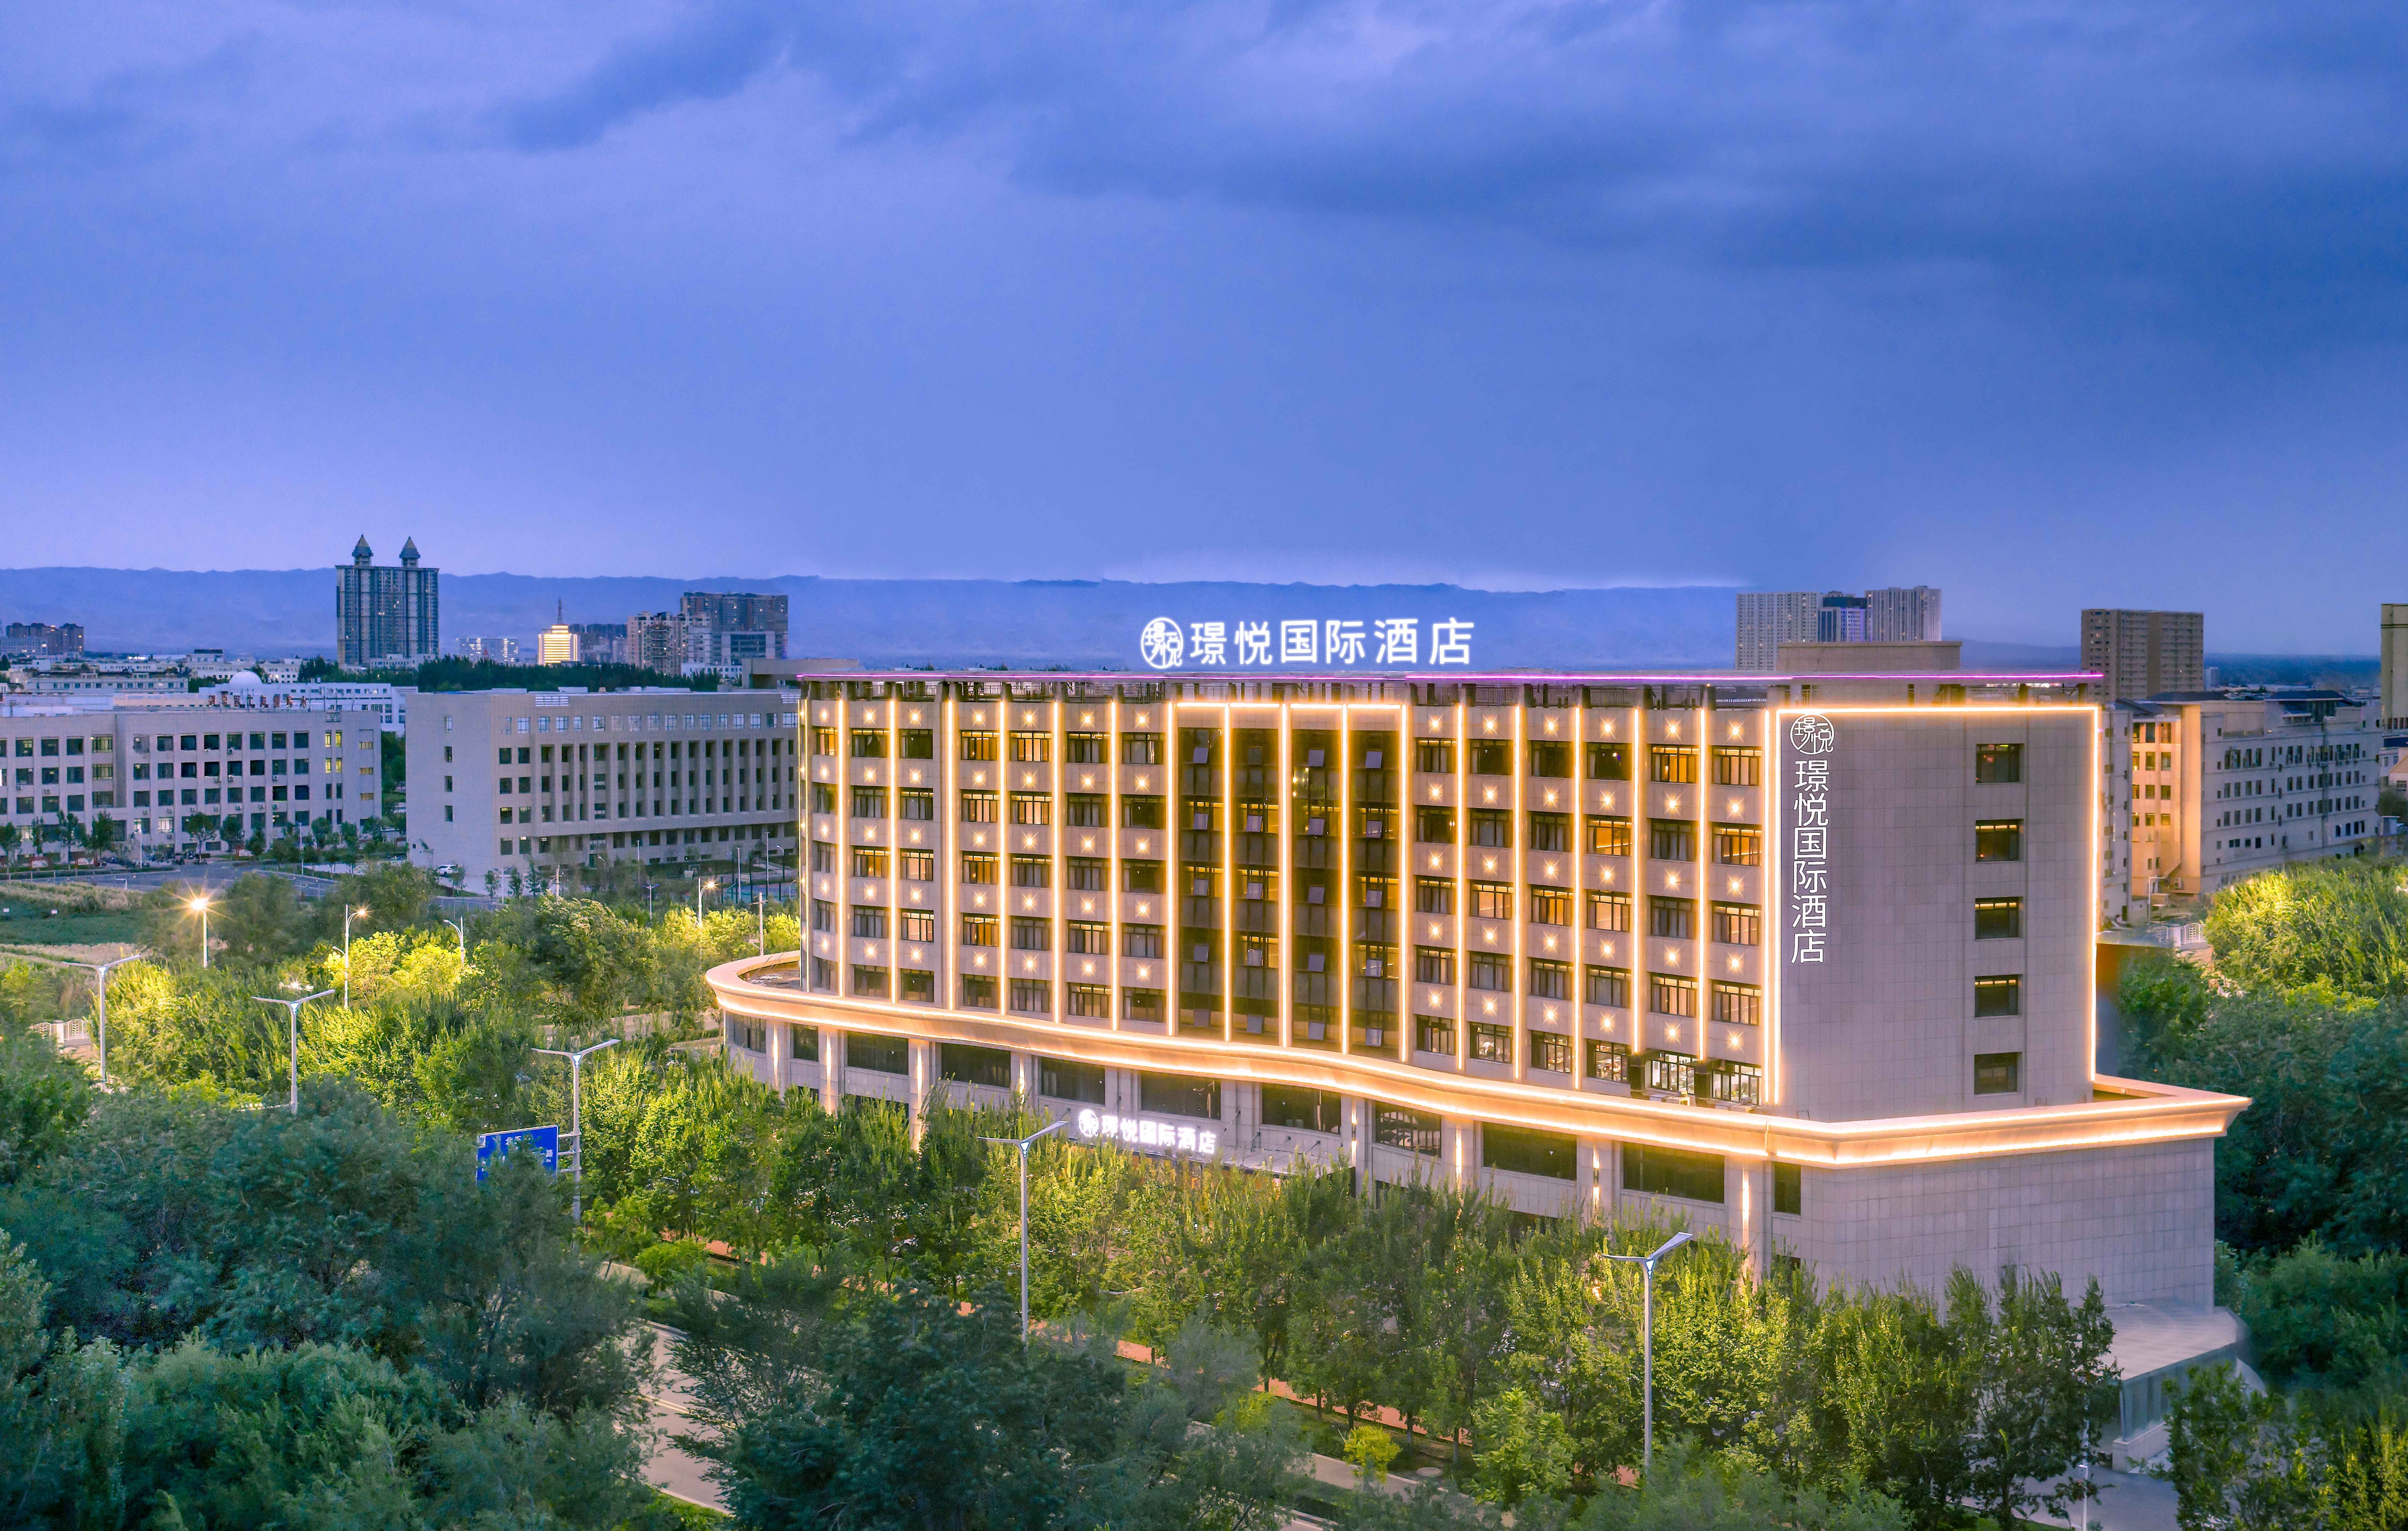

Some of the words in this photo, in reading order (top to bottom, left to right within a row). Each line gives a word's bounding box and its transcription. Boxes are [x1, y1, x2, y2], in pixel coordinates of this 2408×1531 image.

[1191, 618, 1473, 664] 璟悦国际酒店
[1791, 760, 1829, 963] 璟悦国际酒店
